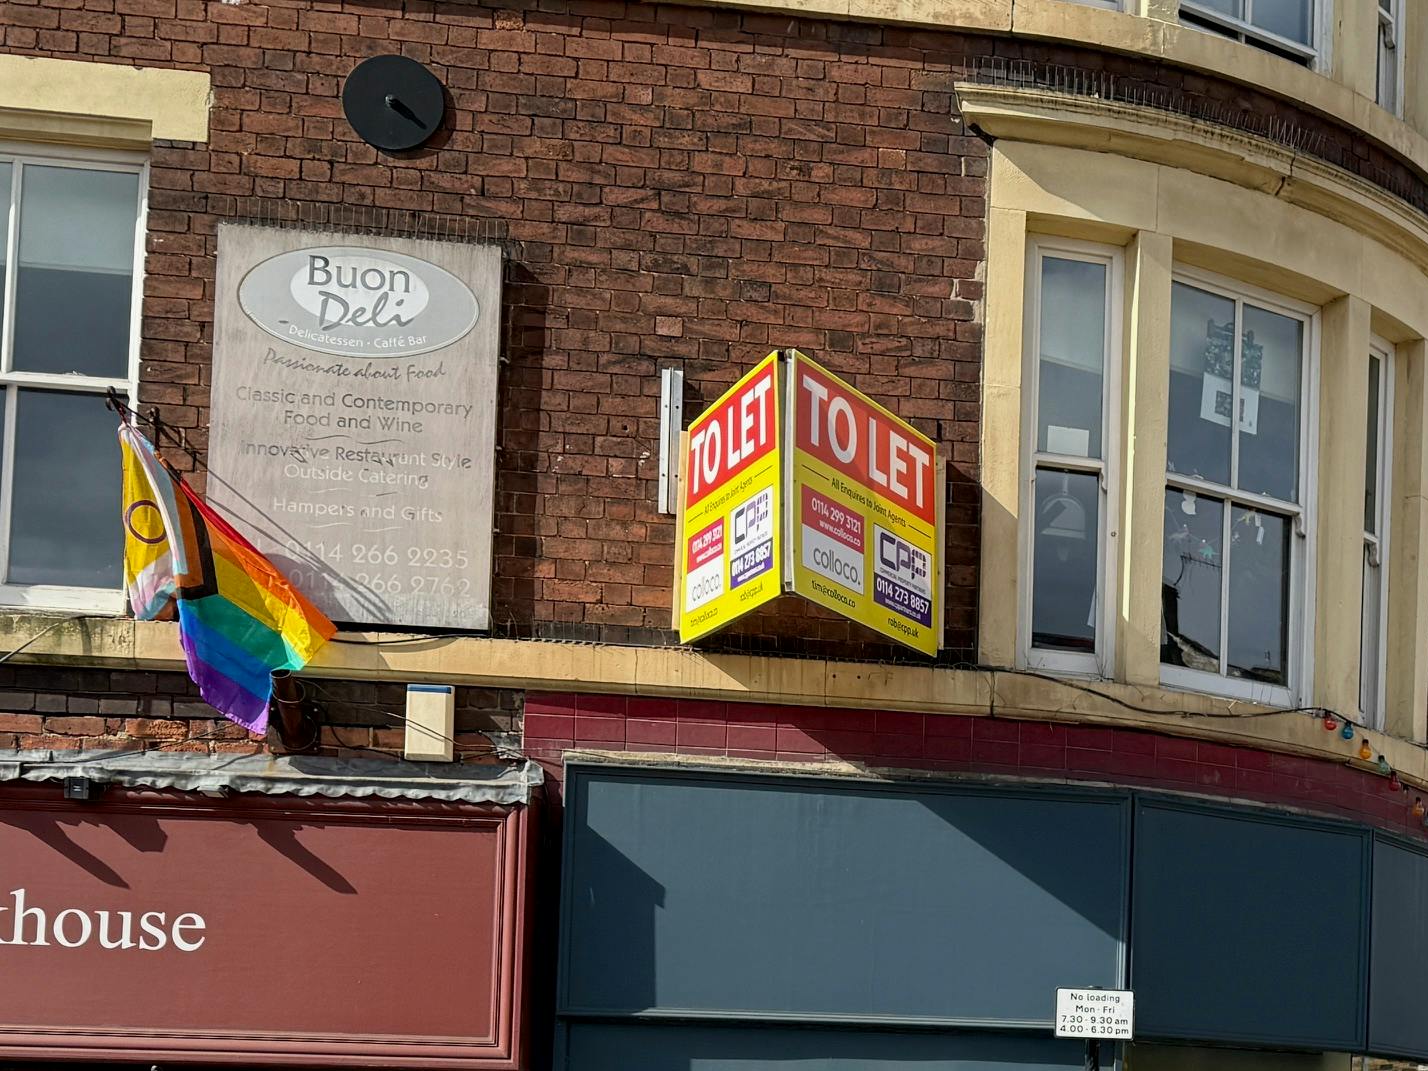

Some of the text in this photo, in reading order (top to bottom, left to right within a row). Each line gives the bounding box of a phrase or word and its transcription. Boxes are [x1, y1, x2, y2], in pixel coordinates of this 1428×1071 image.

[308, 254, 410, 293] Buon
[318, 291, 415, 332] Deli
[289, 325, 363, 347] Delicatessen
[409, 335, 428, 346] Bar
[263, 347, 446, 382] Passionate about Food
[236, 385, 473, 419] Classic and Contemporary
[284, 410, 423, 433] Food and Wine
[690, 374, 771, 495] TO LET
[803, 374, 930, 509] TO LET
[431, 452, 472, 471] Style
[284, 463, 429, 490] Outside Catering
[831, 478, 840, 491] All
[273, 497, 443, 523] Hampers and Gifts
[811, 497, 861, 534] 0114 299 3121
[351, 544, 398, 566] 266
[407, 547, 468, 569] 2235
[410, 576, 471, 598] 2762
[876, 577, 930, 615] 0114 273 8857
[1070, 993, 1121, 1003] No loading
[1075, 1005, 1096, 1013] Mon
[1103, 1006, 1115, 1014] Fri
[1060, 1025, 1084, 1033] 4.00
[1091, 1025, 1113, 1034] 6.30
[1061, 1015, 1083, 1024] 7.30
[1090, 1016, 1113, 1025] 9.30
[1114, 1018, 1129, 1026] am
